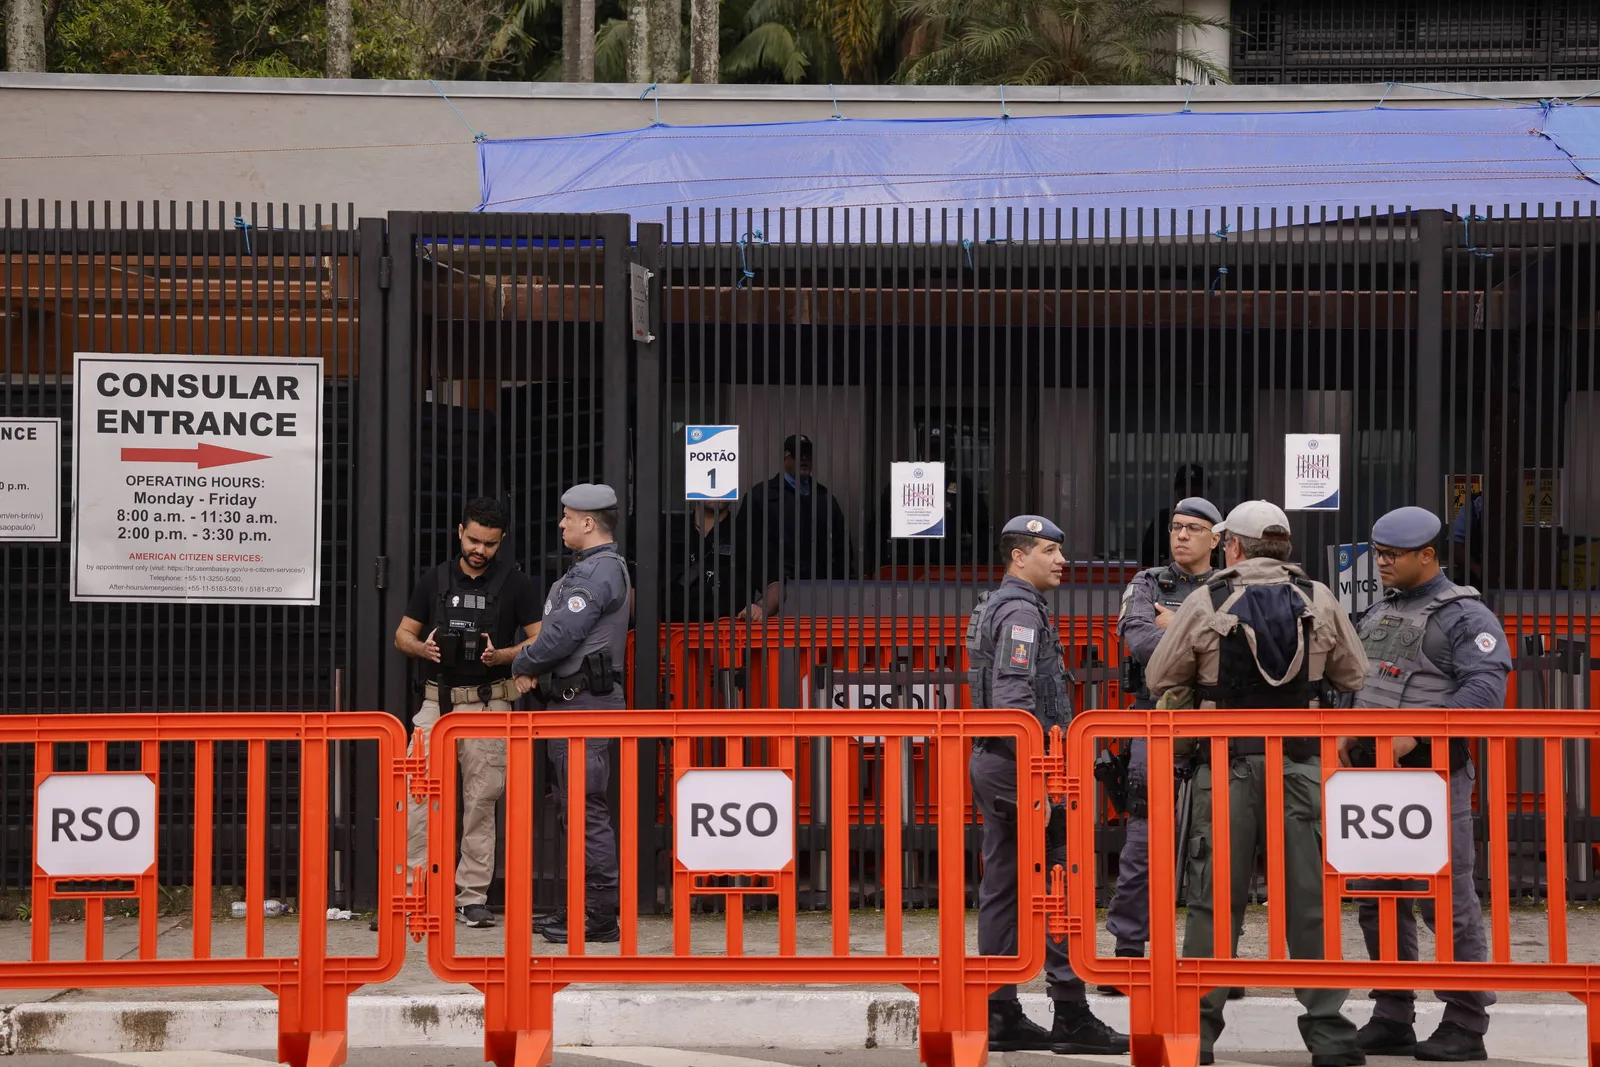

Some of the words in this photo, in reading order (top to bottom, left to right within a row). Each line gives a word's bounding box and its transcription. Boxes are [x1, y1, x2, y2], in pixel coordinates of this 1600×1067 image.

[96, 372, 300, 400] CONSULAR
[97, 409, 296, 436] ENTRANCE
[690, 450, 736, 462] PORTÃO
[126, 476, 207, 487] OPERATING
[211, 477, 265, 488] HOURS:
[707, 468, 716, 489] 1
[8, 483, 30, 491] p.m.
[134, 492, 194, 508] Monday
[209, 493, 257, 508] Friday
[117, 509, 148, 522] 8:00
[154, 512, 185, 522] a.m.
[201, 511, 241, 523] 11:30
[246, 514, 277, 524] a.m.
[118, 527, 150, 539] 2:00
[155, 530, 187, 542] p.m.
[202, 529, 234, 541] 3:30
[239, 531, 271, 543] p.m.
[129, 553, 176, 561] AMERICAN
[179, 553, 214, 561] CITIZEN
[216, 554, 264, 562] SERVICES:
[1340, 579, 1378, 594] VITOS
[52, 806, 140, 842] RSO
[691, 802, 778, 837] RSO
[1340, 804, 1432, 839] RSO
